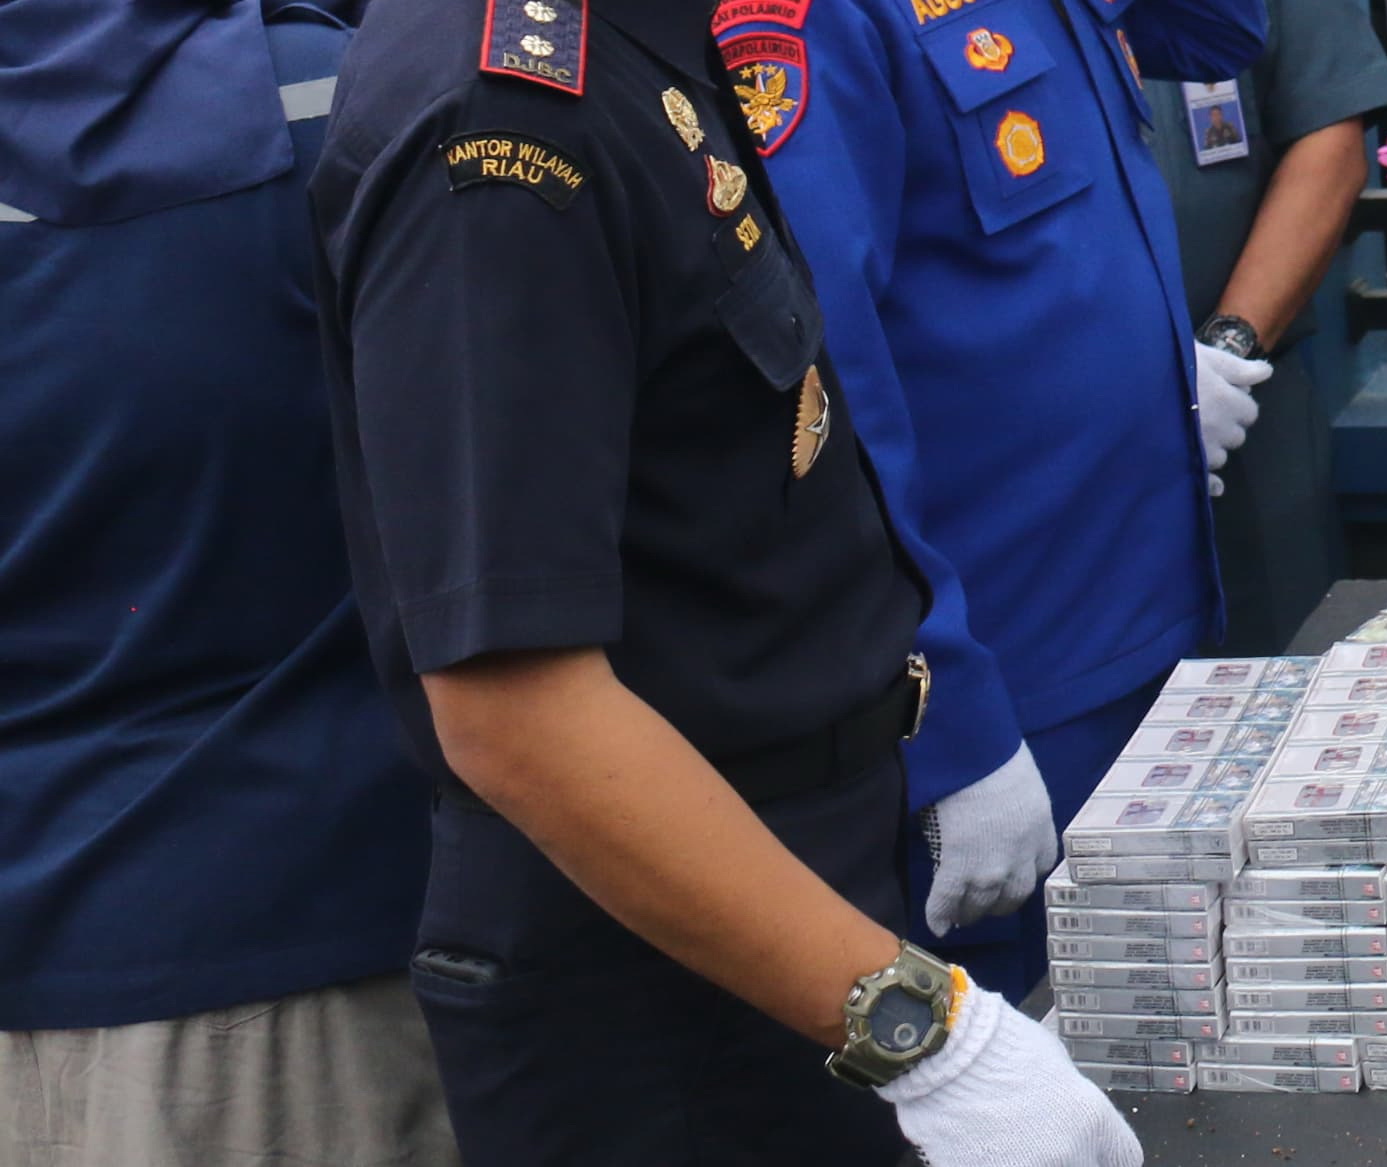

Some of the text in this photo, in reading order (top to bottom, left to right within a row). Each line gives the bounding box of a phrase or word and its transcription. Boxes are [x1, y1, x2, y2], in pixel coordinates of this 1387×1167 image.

[503, 51, 572, 83] DJBC
[447, 139, 583, 189] KANTOR WILAYAH
[482, 159, 544, 184] RIAU
